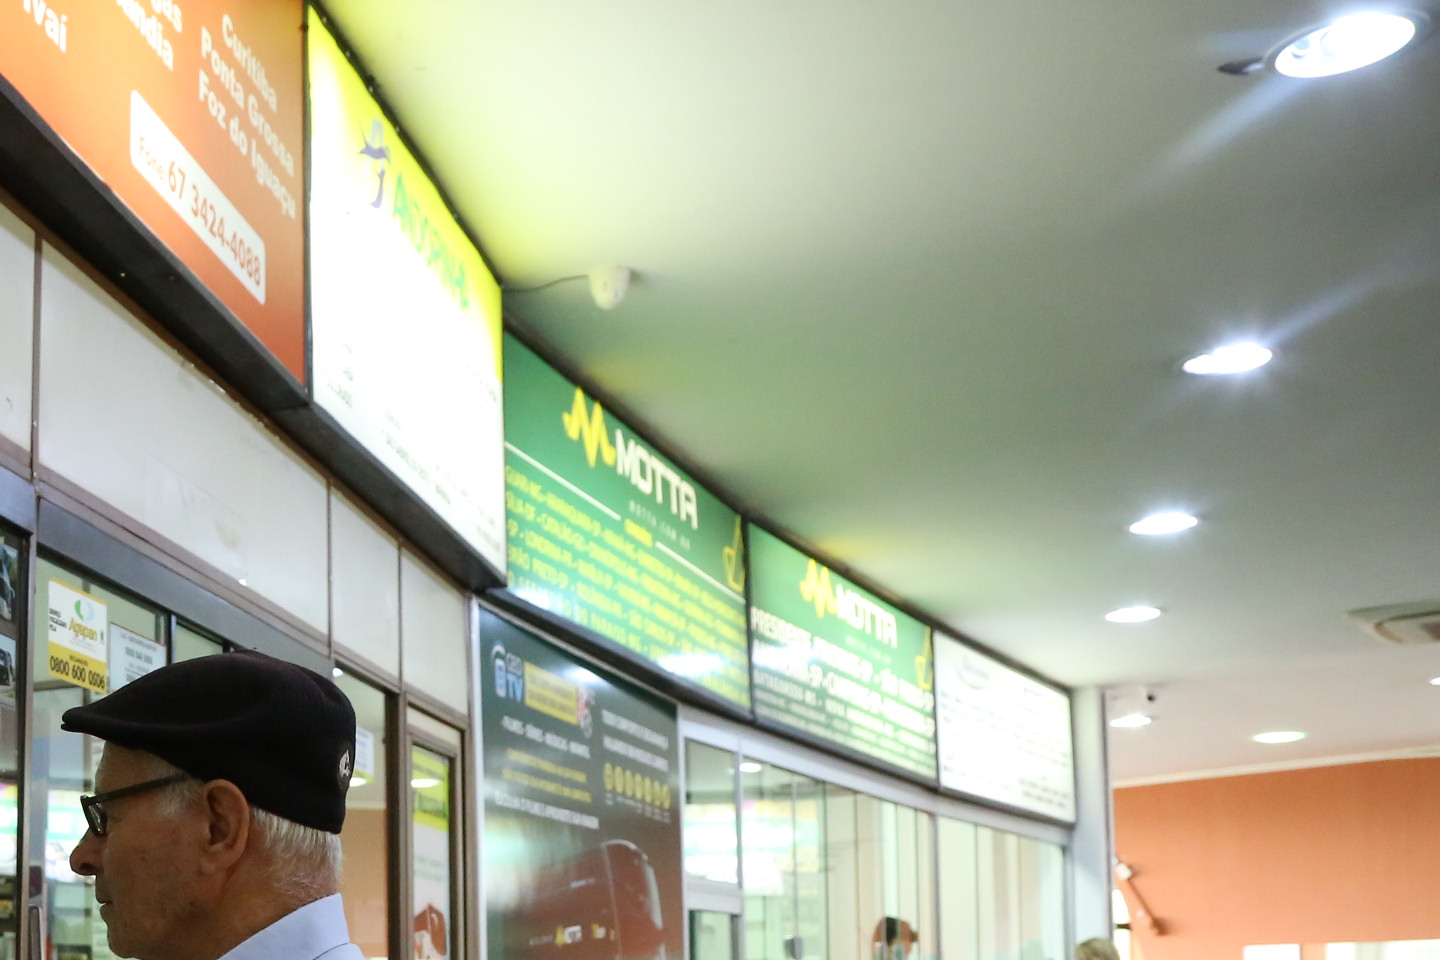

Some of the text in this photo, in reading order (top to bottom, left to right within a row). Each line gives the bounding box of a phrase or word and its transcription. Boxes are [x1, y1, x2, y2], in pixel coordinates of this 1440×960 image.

[23, 0, 66, 53] vai
[116, 0, 174, 71] andia
[221, 13, 278, 113] Curitiba
[198, 68, 296, 221] Foz do Iguaçu
[201, 25, 295, 178] Ponta Grossa
[168, 161, 187, 200] 67
[191, 184, 261, 287] 3424-4088
[615, 428, 698, 530] MOTTA
[50, 656, 70, 676] 0800
[72, 664, 86, 682] 600
